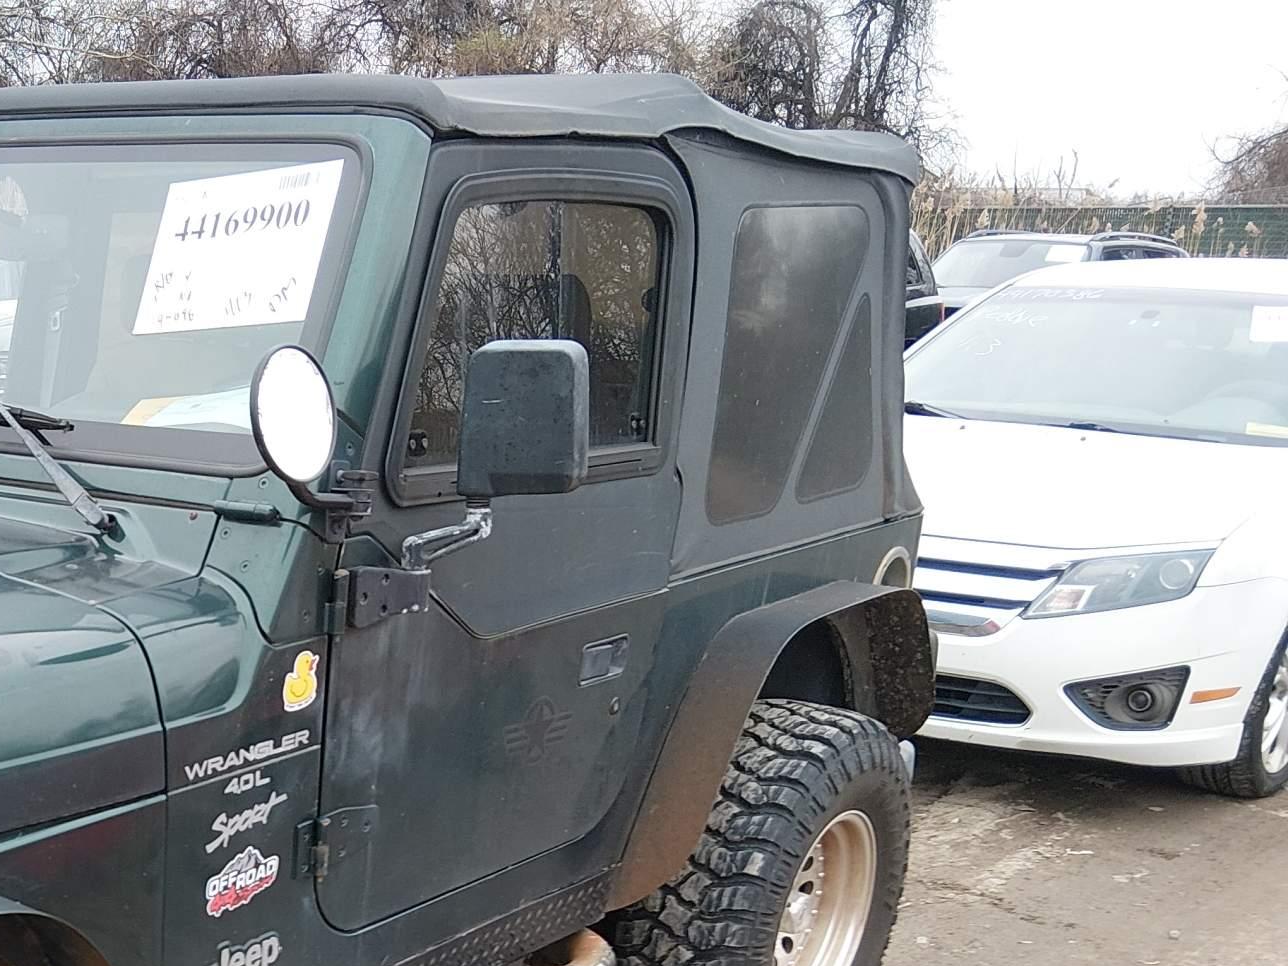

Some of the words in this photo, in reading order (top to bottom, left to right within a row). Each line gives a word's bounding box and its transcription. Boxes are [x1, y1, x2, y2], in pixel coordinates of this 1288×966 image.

[175, 198, 311, 242] 44169900
[184, 729, 311, 781] WRANGLER
[204, 791, 289, 854] Sport
